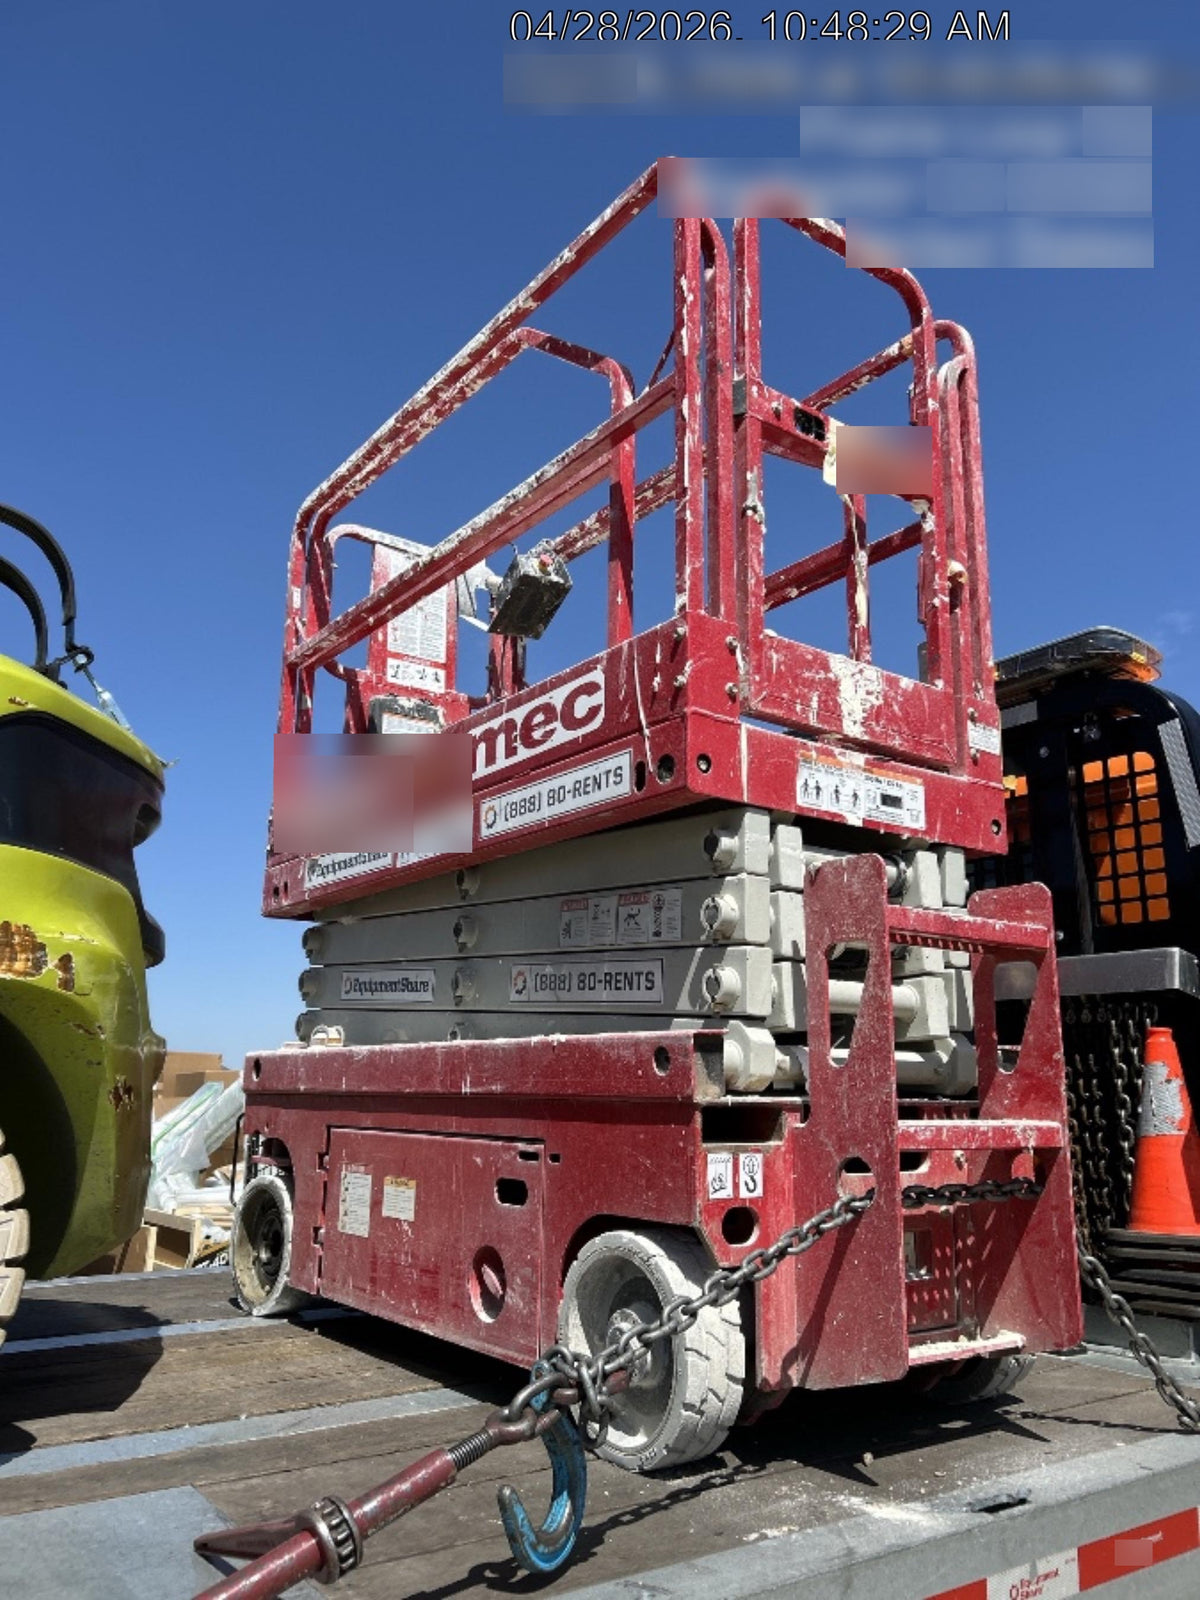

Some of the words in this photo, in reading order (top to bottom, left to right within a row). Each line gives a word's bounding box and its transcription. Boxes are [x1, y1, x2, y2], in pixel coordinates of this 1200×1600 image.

[472, 681, 602, 774] mec
[503, 791, 542, 822] (888)
[547, 765, 623, 808] 80-RENTS
[353, 976, 429, 996] EquipmentShare
[534, 972, 572, 993] (888)
[577, 971, 655, 992] 80-RENTS
